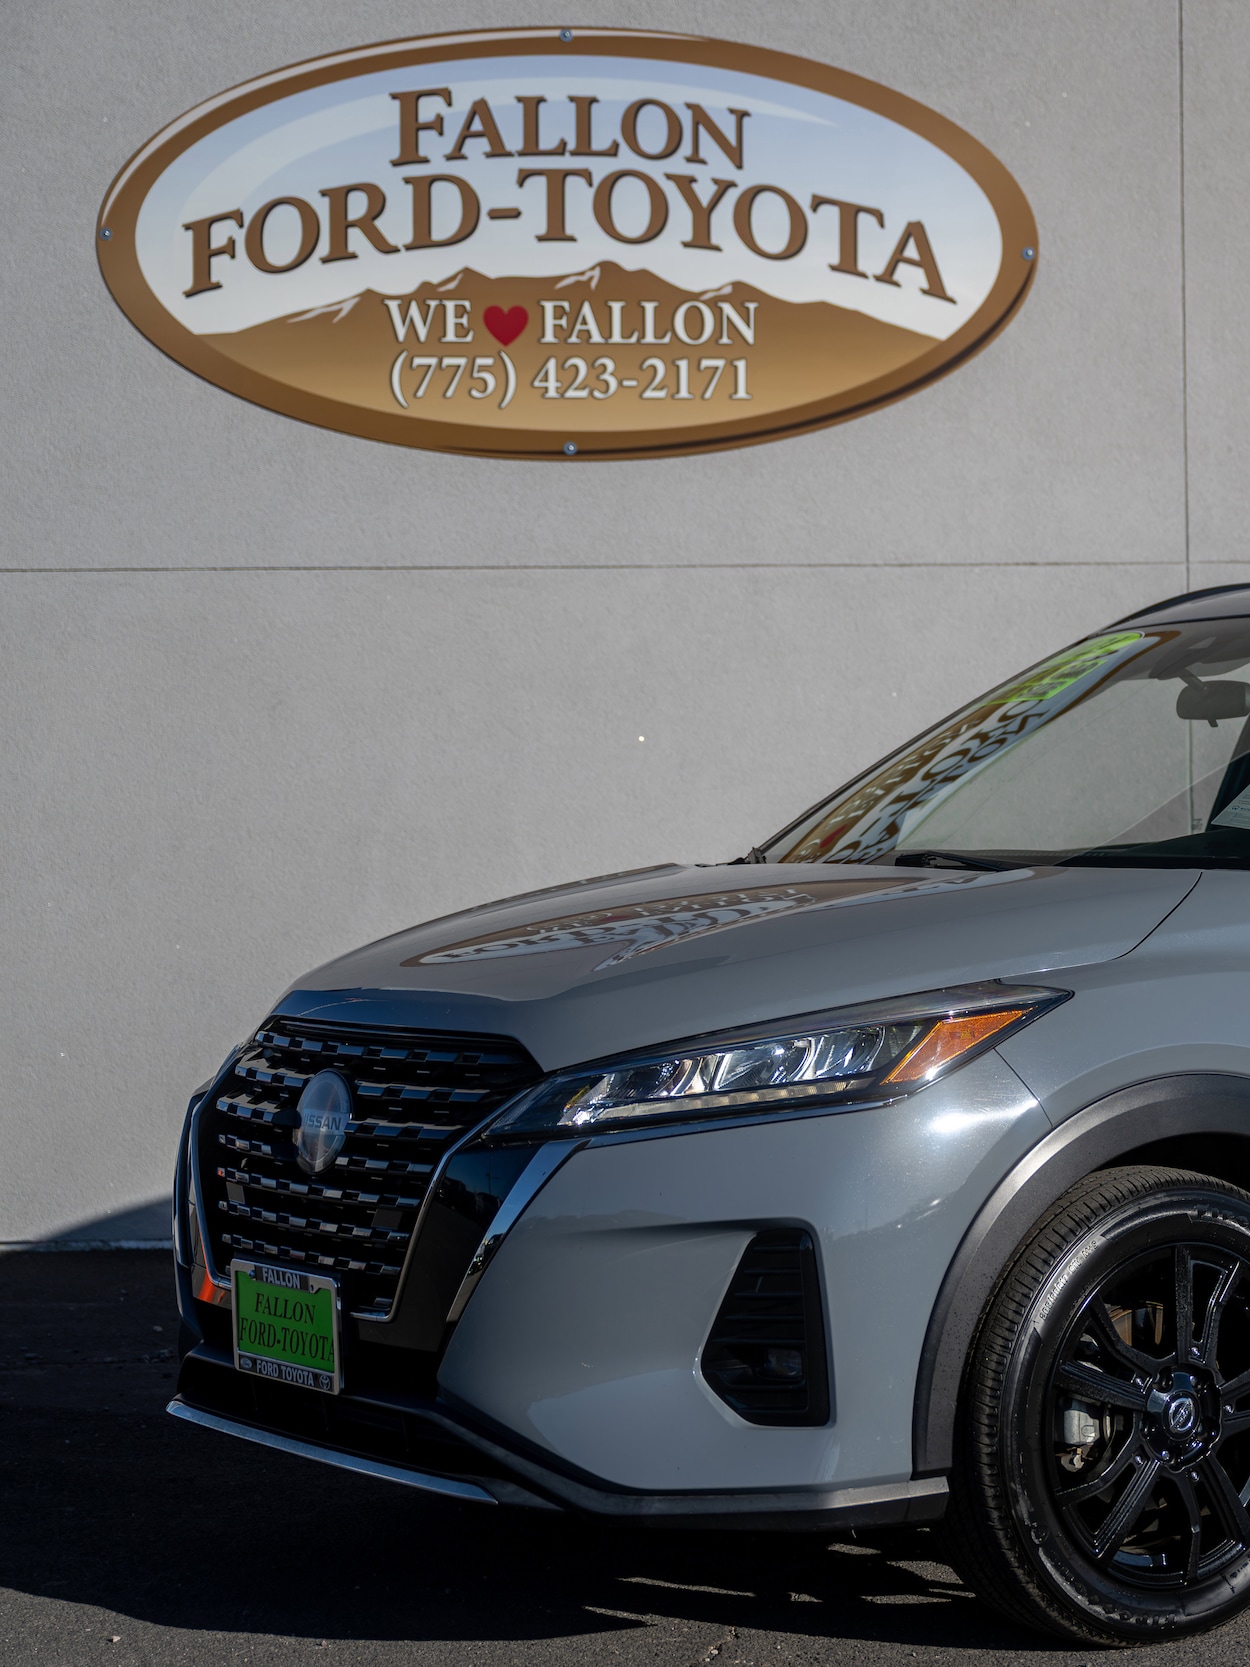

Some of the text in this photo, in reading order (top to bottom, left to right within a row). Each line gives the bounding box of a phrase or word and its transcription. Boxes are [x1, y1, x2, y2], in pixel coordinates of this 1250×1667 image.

[389, 87, 751, 170] FALLON
[182, 167, 957, 305] FORD-TOYOTA
[383, 299, 760, 346] WE FALLON
[391, 349, 752, 409] (775) 423-2171
[262, 1267, 301, 1289] FALLON
[255, 1292, 317, 1325] FALLON
[256, 1359, 279, 1378] FORD
[281, 1365, 315, 1387] TOYOTA
